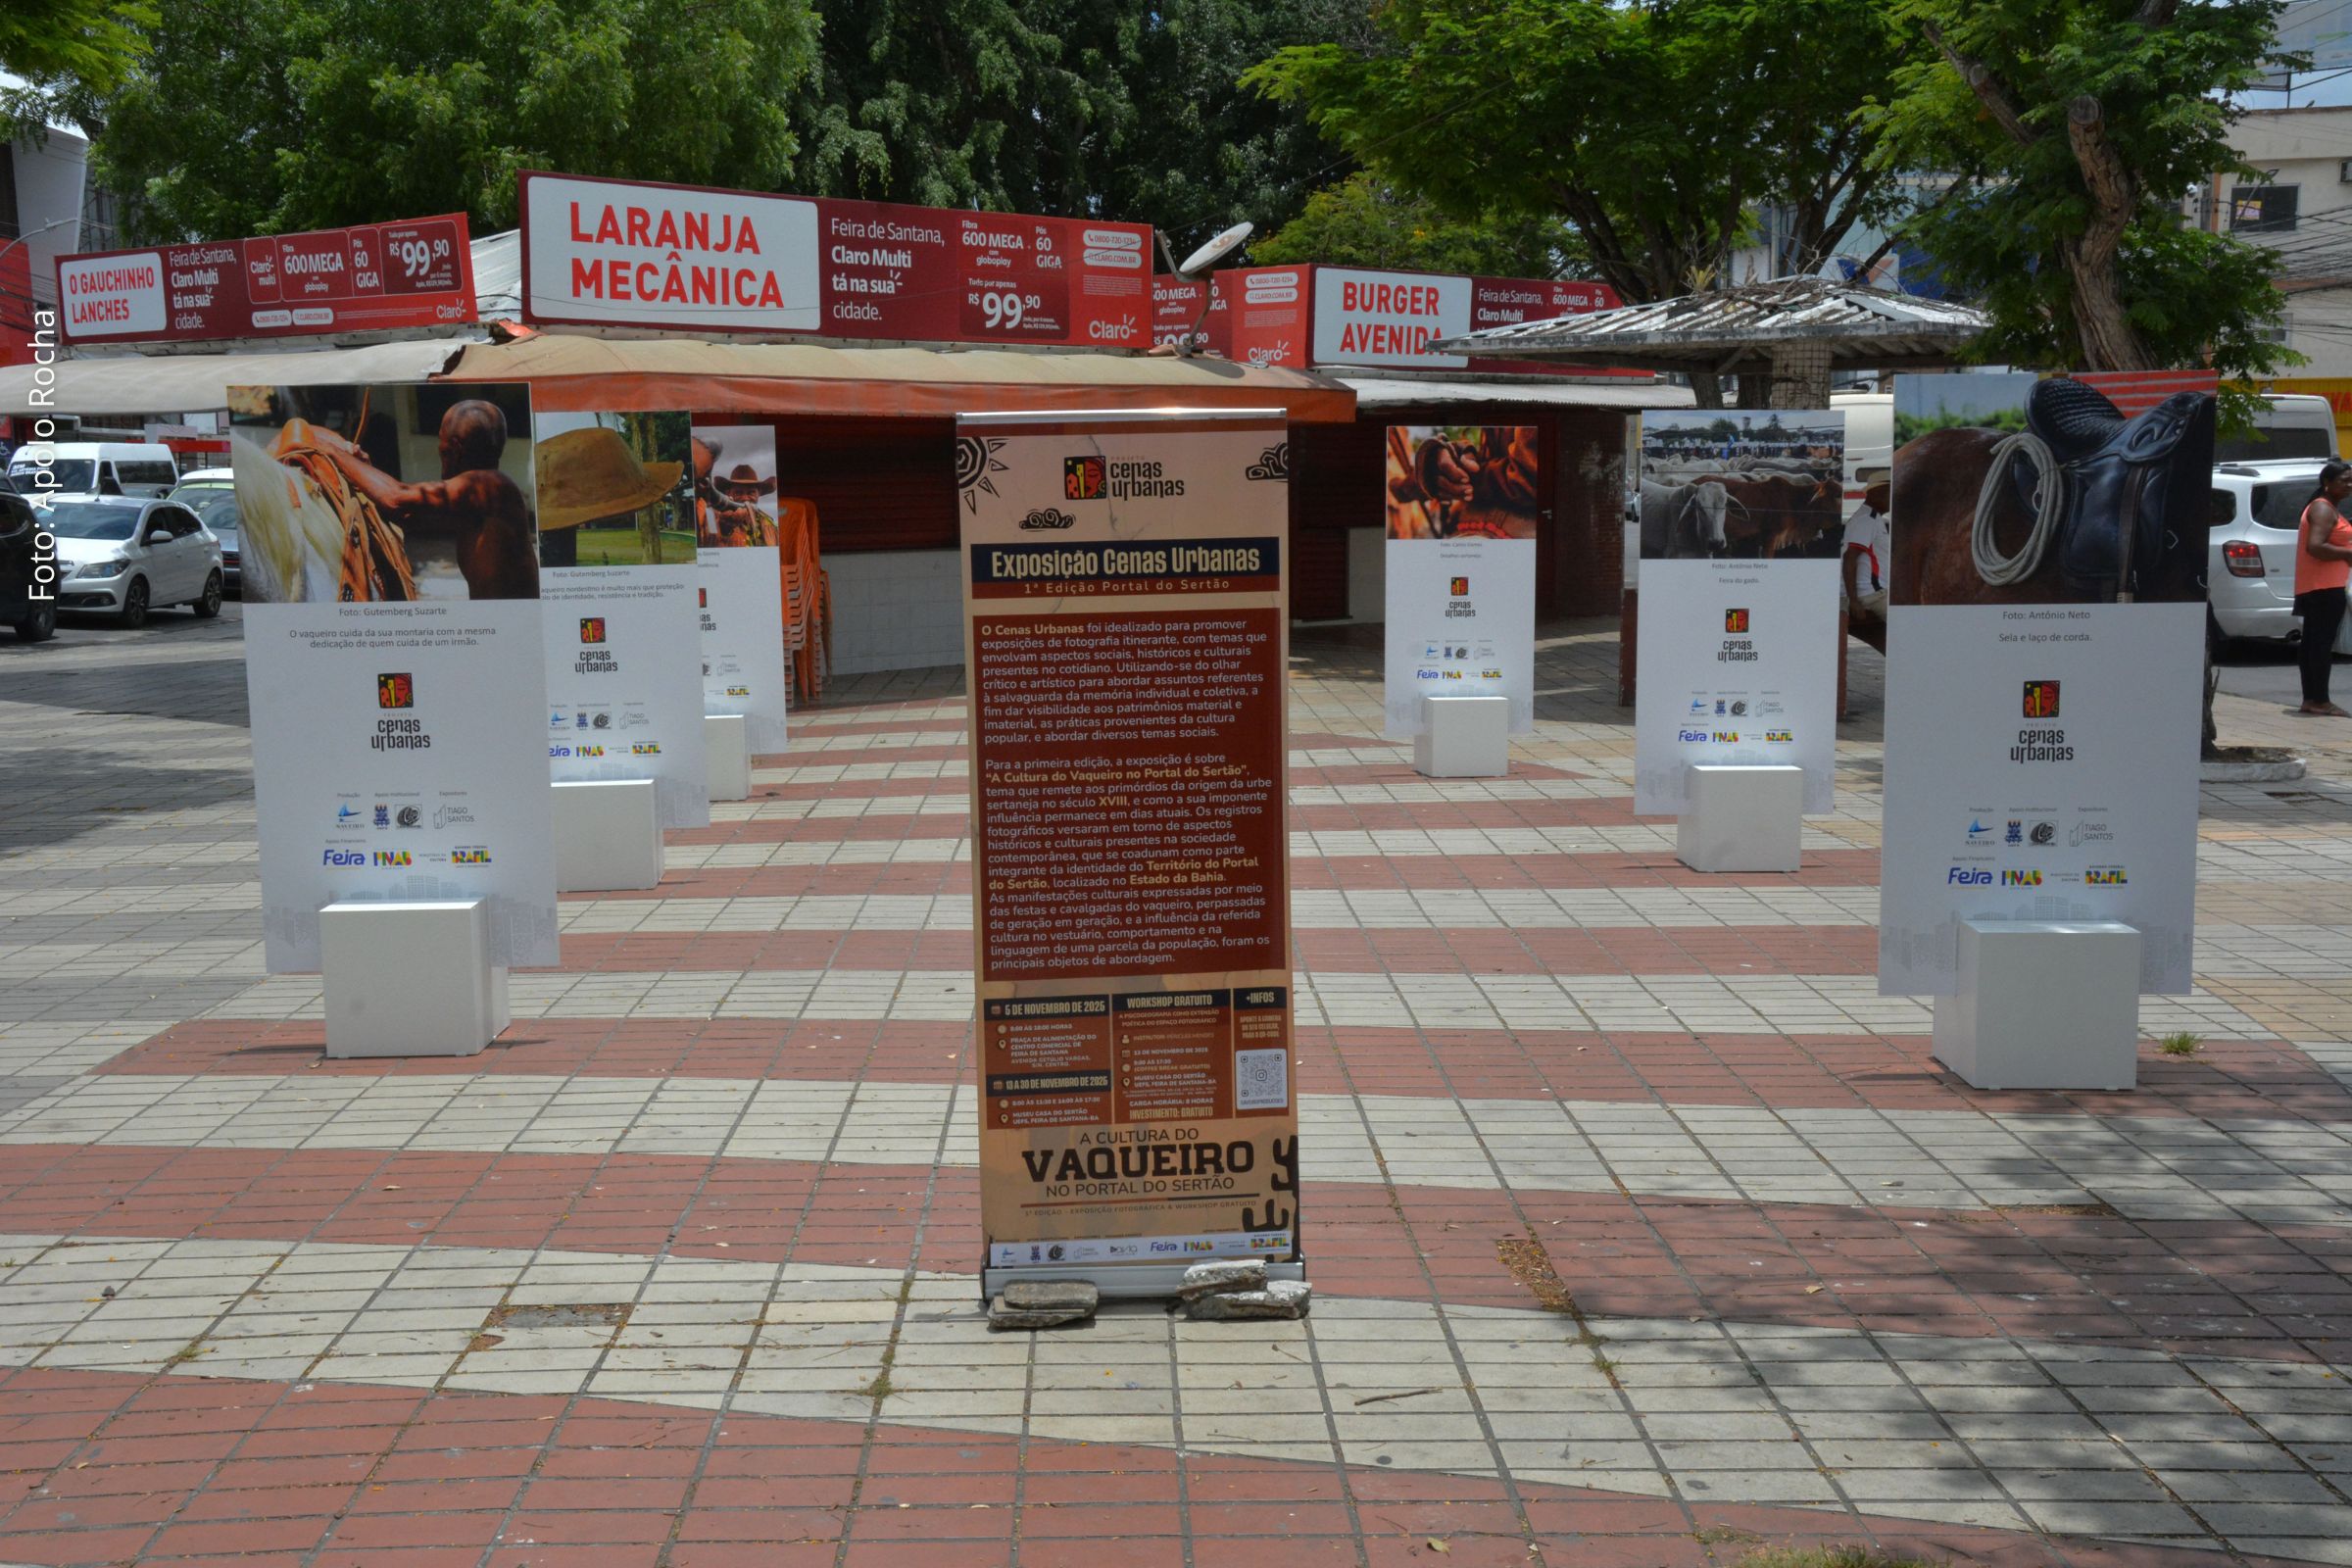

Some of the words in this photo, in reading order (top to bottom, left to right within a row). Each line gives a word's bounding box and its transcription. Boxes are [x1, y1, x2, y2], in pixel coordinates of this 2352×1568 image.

[570, 201, 760, 255] LARANJA
[831, 218, 865, 238] Feira
[867, 220, 885, 239] de
[887, 222, 945, 247] Santana,
[962, 220, 977, 229] Fibra
[1035, 225, 1047, 234] Pós
[962, 231, 987, 246] 600
[989, 233, 1024, 250] MEGA
[1036, 237, 1052, 251] 60
[170, 250, 189, 268] Feira
[189, 249, 200, 266] de
[201, 247, 236, 265] Santana,
[389, 242, 400, 257] R$
[831, 245, 869, 266] Claro
[872, 248, 911, 268] Multi
[250, 261, 271, 274] Claro
[284, 255, 309, 274] 600
[309, 252, 344, 272] MEGA
[354, 251, 368, 268] 60
[976, 256, 1011, 268] globoplay
[1037, 255, 1062, 269] GIGA
[70, 273, 77, 295] O
[80, 267, 155, 293] GAUCHINHO
[172, 270, 194, 288] Claro
[195, 268, 219, 286] Multi
[259, 275, 276, 286] multi
[356, 271, 379, 288] GIGA
[571, 251, 784, 308] MECÂNICA
[832, 272, 848, 291] tá
[850, 277, 868, 292] na
[996, 280, 1017, 289] apenas
[304, 281, 328, 293] globoplay
[1169, 286, 1197, 300] MEGA
[173, 293, 184, 310] tá
[184, 295, 194, 308] na
[968, 293, 980, 306] R$
[1343, 281, 1440, 316] BURGER
[1479, 288, 1498, 302] Feira
[1499, 290, 1509, 303] de
[1510, 290, 1544, 305] Santana,
[1552, 294, 1567, 305] 600
[1568, 295, 1589, 307] MEGA
[1594, 297, 1604, 308] 60
[72, 298, 129, 324] LANCHES
[436, 304, 463, 319] Claro
[833, 301, 882, 320] cidade.
[1478, 308, 1499, 321] Claro
[1500, 309, 1523, 321] Multi
[175, 313, 205, 330] cidade.
[1089, 320, 1130, 340] Claro
[1249, 347, 1283, 363] Claro
[1110, 462, 1162, 480] cenas
[1112, 479, 1184, 501] urbanas
[992, 550, 1098, 580] Exposição
[1103, 548, 1166, 574] Cenas
[1172, 547, 1260, 573] Urbanas
[1046, 581, 1095, 595] Edição
[1102, 579, 1149, 592] Portal
[1156, 579, 1173, 590] do
[1181, 578, 1230, 590] Sertão
[364, 608, 413, 617] Gutemberg
[415, 607, 447, 615] Suzarte
[1446, 610, 1476, 618] urbanas
[2068, 611, 2090, 619] Neto
[299, 629, 337, 640] vaqueiro
[339, 628, 363, 637] cuida
[365, 628, 375, 637] da
[981, 625, 992, 636] O
[995, 624, 1031, 635] Cenas
[1034, 623, 1084, 634] Urbanas
[1087, 622, 1102, 633] foi
[1104, 621, 1161, 632] idealizado
[1165, 622, 1190, 633] para
[1193, 621, 1247, 633] promover
[310, 639, 354, 649] dedicação
[369, 640, 394, 649] quem
[396, 638, 419, 647] cuida
[981, 637, 1045, 652] exposições
[1047, 637, 1061, 648] de
[1064, 635, 1119, 650] fotografia
[1122, 634, 1179, 647] itinerante,
[1208, 633, 1245, 643] temas
[1246, 634, 1266, 645] que
[1723, 640, 1752, 651] cenas
[2029, 633, 2047, 643] laço
[2049, 633, 2061, 642] de
[579, 651, 611, 662] cenas
[982, 651, 1037, 662] envolvam
[1040, 651, 1090, 663] aspectos
[1093, 649, 1134, 661] sociais,
[1137, 647, 1191, 659] históricos
[1203, 645, 1250, 657] culturais
[1718, 651, 1758, 663] urbanas
[575, 662, 618, 674] urbanas
[1417, 669, 1439, 679] Feira
[377, 718, 420, 734] cenas
[371, 734, 431, 752] urbanas
[1679, 730, 1707, 742] Feira
[2019, 729, 2064, 745] cenas
[2010, 746, 2074, 763] urbanas
[987, 811, 1041, 822] influência
[1045, 811, 1106, 823] permanece
[1109, 810, 1127, 819] em
[1130, 808, 1152, 818] dias
[1155, 807, 1193, 817] atuais.
[1196, 806, 1210, 816] Os
[1214, 804, 1262, 818] registros
[322, 849, 366, 865] Feira
[1948, 867, 1993, 885] Feira
[991, 956, 1045, 971] principais
[1048, 956, 1089, 969] objetos
[1092, 955, 1105, 965] de
[1108, 953, 1175, 967] abordagem.
[1004, 1004, 1010, 1015] 5
[1012, 1004, 1024, 1015] DE
[1024, 1002, 1071, 1014] NOVEMBRO
[1072, 1001, 1082, 1012] DE
[1127, 996, 1172, 1008] WORKSHOP
[1174, 995, 1213, 1006] GRATUITO
[1129, 1107, 1180, 1120] INVESTIMENTO:
[1181, 1106, 1213, 1117] GRATUITO
[1080, 1133, 1092, 1146] A
[1096, 1130, 1169, 1145] CULTURA
[1175, 1128, 1199, 1141] DO
[1022, 1141, 1254, 1183] VAQUEIRO
[1047, 1185, 1070, 1198] NO
[1076, 1182, 1138, 1196] PORTAL
[1144, 1180, 1166, 1193] DO
[1172, 1175, 1235, 1192] SERTÃO
[1151, 1241, 1177, 1252] Feira
